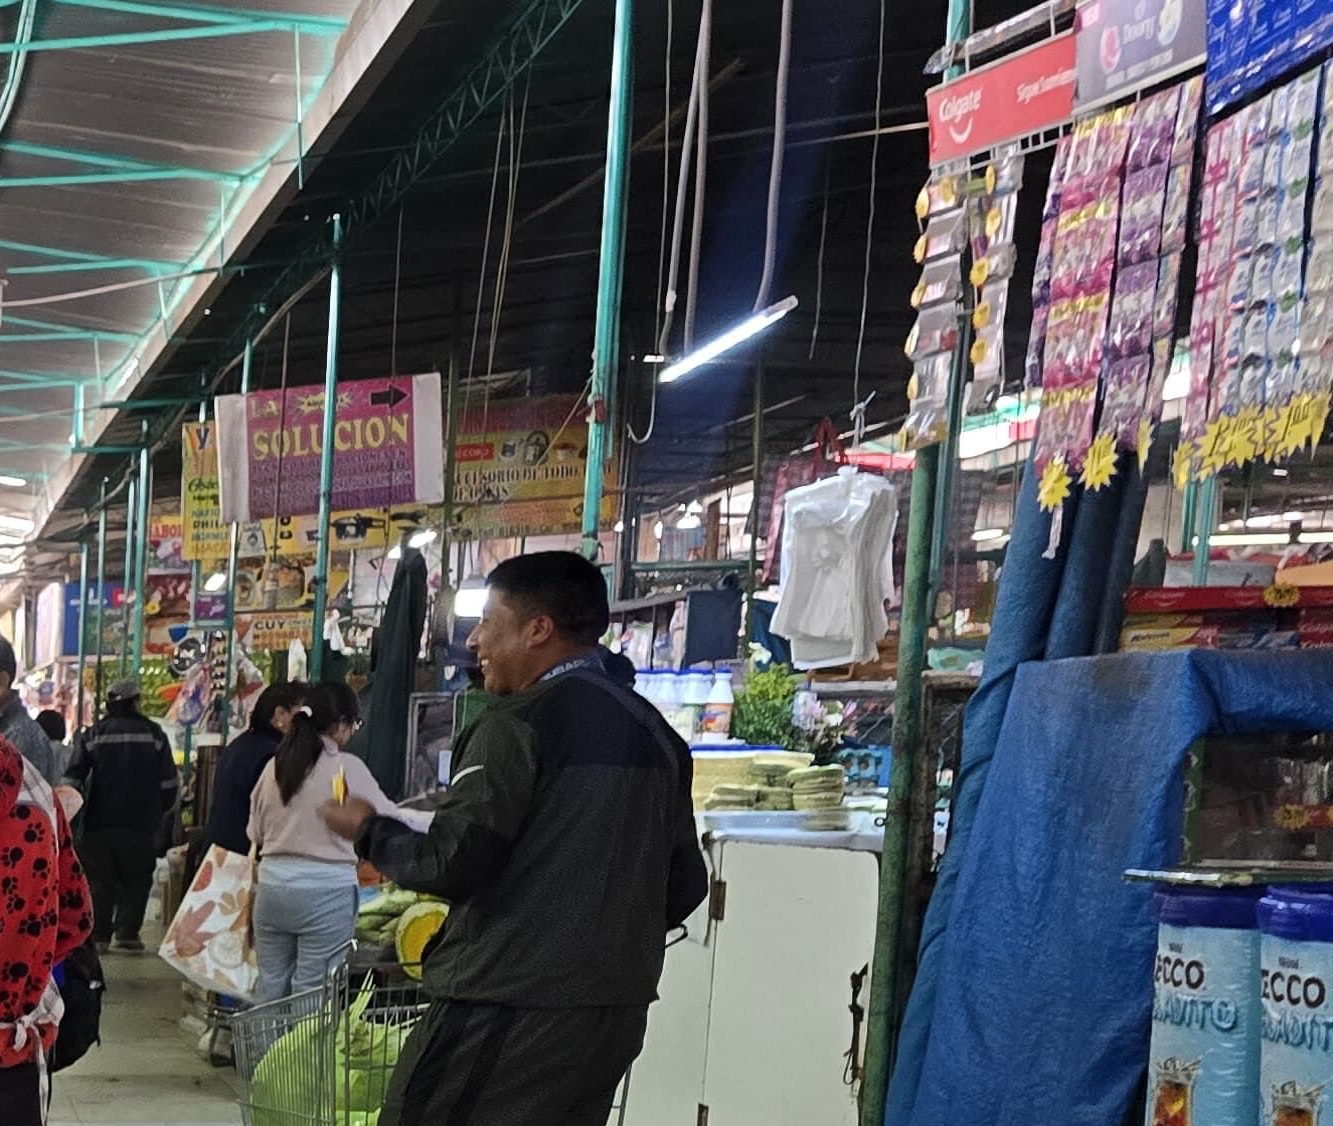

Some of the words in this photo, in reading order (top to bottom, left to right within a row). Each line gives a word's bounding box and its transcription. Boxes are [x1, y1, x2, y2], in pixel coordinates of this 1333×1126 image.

[939, 88, 982, 123] Colgate
[250, 399, 279, 419] LA
[252, 413, 410, 461] SOLUCION
[1154, 954, 1206, 990] ECCO
[1261, 968, 1327, 1009] ECCO
